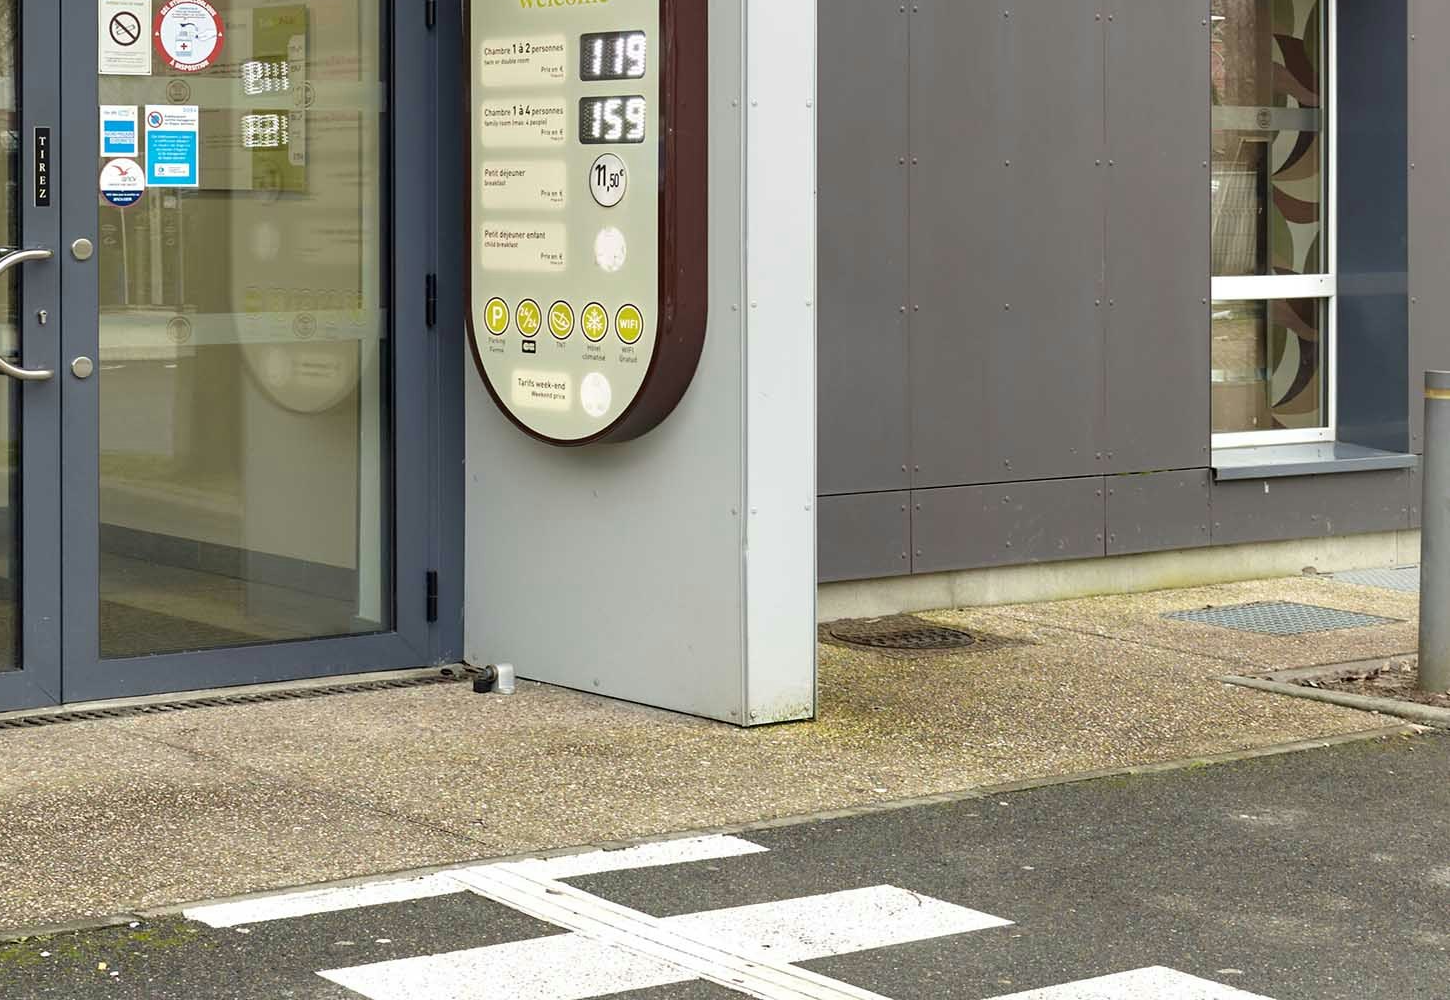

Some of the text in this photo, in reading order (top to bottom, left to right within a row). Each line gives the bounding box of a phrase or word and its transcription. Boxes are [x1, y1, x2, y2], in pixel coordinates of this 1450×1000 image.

[484, 42, 564, 55] Chambre 1 à 2 personnes
[592, 33, 646, 77] 119
[512, 105, 516, 115] 1
[518, 104, 524, 115] à
[525, 105, 531, 115] 4
[531, 108, 564, 116] personnes
[592, 98, 646, 140] 159
[38, 136, 47, 199] TIREZ
[484, 168, 499, 176] Petit
[484, 230, 499, 238] Petit
[526, 231, 546, 239] enfant
[619, 320, 638, 329] WIFI
[518, 377, 566, 390] Tarifs week-end
